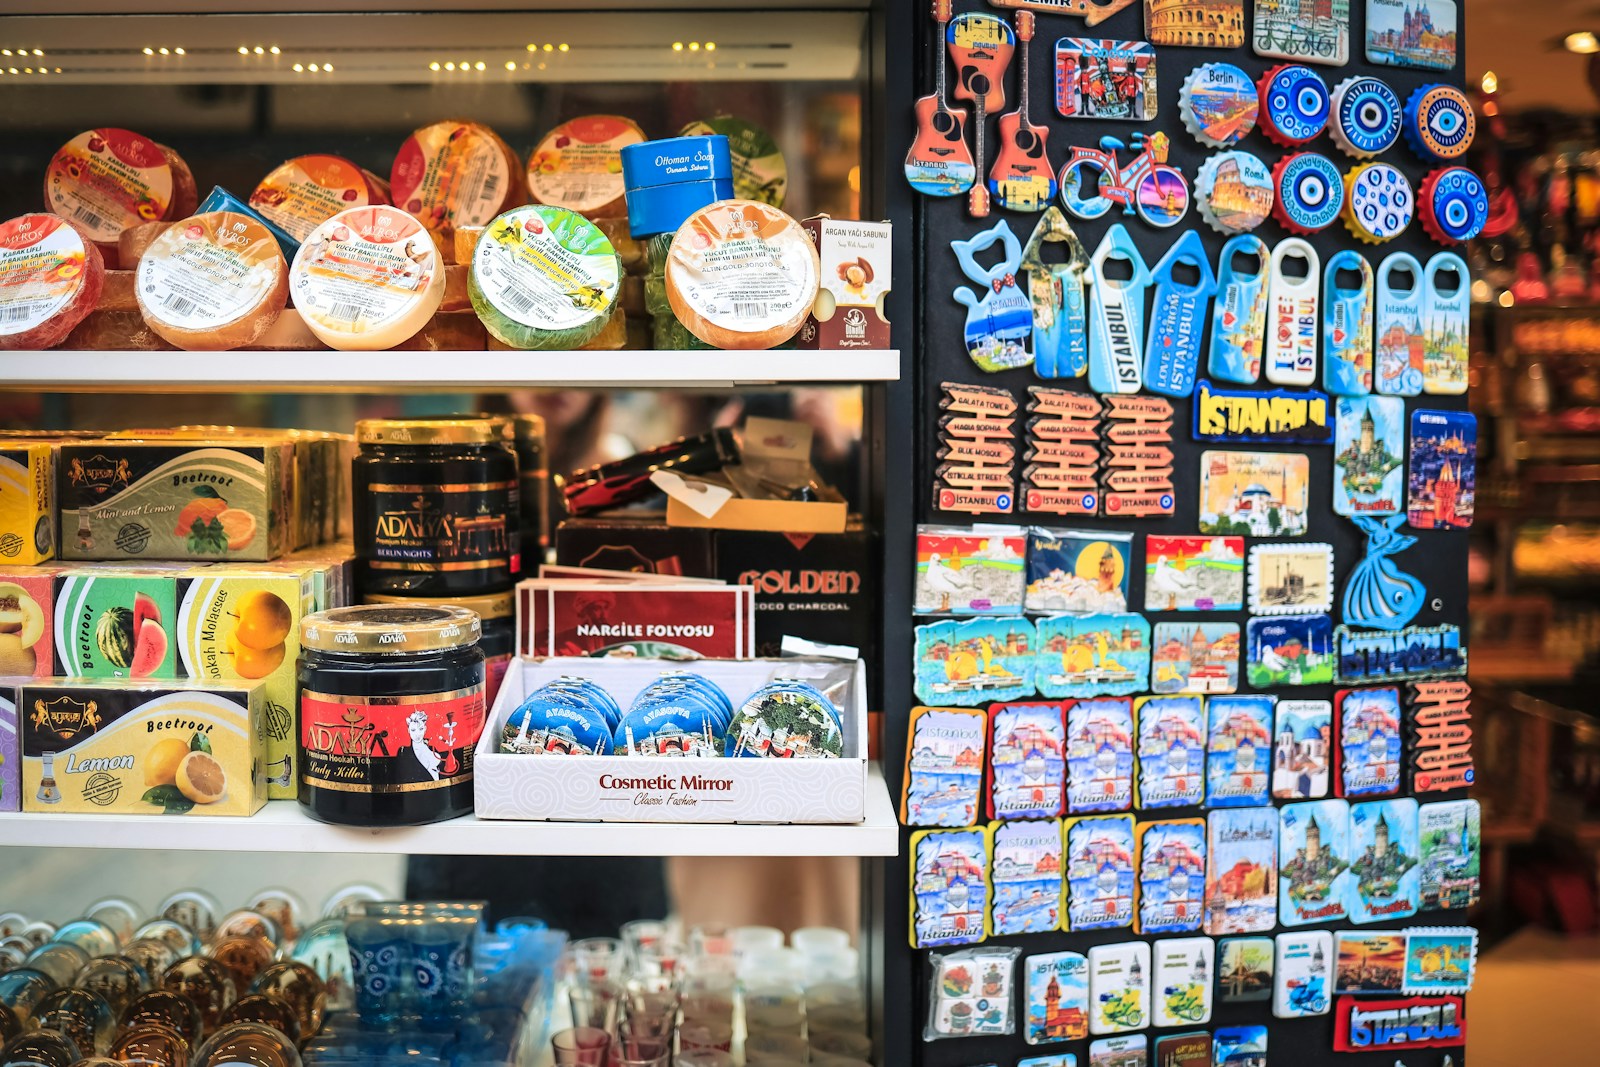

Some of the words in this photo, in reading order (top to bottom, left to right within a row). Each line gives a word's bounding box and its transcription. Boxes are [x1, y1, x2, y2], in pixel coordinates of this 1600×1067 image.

[1082, 44, 1134, 59] London
[1209, 69, 1234, 84] Berlin
[108, 156, 126, 170] KABAK
[655, 156, 689, 166] Ottoman
[694, 151, 714, 162] Soap
[109, 165, 126, 178] BAKIM
[1244, 167, 1264, 181] Roma
[5, 230, 43, 244] MYROS
[216, 226, 252, 246] MYROS
[361, 225, 400, 240] MYROS
[825, 228, 847, 236] ARGAN
[848, 228, 862, 237] YAĞI
[355, 241, 377, 250] KABAK
[377, 243, 393, 253] LİFLİ
[721, 239, 746, 249] KABAK
[3, 248, 26, 258] KABAK
[26, 246, 42, 254] LİFLİ
[8, 255, 30, 264] BAKIM
[31, 250, 58, 260] SABUNU
[358, 247, 380, 258] BAKIM
[380, 252, 406, 263] SABUNU
[546, 237, 567, 256] KABAK
[567, 253, 582, 266] LİFLİ
[205, 248, 225, 260] BAKIM
[225, 256, 250, 272] SABUNU
[546, 247, 567, 264] BAKIM
[566, 260, 592, 280] SABUNU
[1385, 304, 1418, 315] Istanbul
[1069, 278, 1085, 372] GREECE
[1157, 352, 1170, 387] LOVE
[1166, 293, 1180, 333] FROM
[1297, 297, 1315, 371] ISTANBUL
[1104, 302, 1138, 383] ISTANBUL
[1170, 297, 1196, 390] ISTANBUL
[1276, 360, 1294, 370] I
[958, 398, 983, 407] GALATA
[985, 400, 1009, 411] TOWER
[1044, 400, 1069, 409] GALATA
[1071, 402, 1094, 412] TOWER
[1144, 405, 1167, 414] TOWER
[1061, 426, 1086, 434] SOPHIA
[975, 448, 1002, 458] MOSQUE
[1059, 450, 1085, 458] MOSQUE
[173, 472, 234, 487] Beetroot
[977, 473, 1002, 481] STREET
[956, 493, 996, 506] İSTANBUL
[1042, 493, 1082, 506] İSTANBUL
[1122, 495, 1159, 507] İSTANBUL
[96, 509, 118, 519] Mint
[122, 506, 141, 516] and
[144, 503, 176, 514] Lemon
[376, 538, 400, 546] Premium
[378, 549, 401, 557] BERLIN
[738, 570, 860, 594] GOLDEN
[202, 590, 228, 641] Molasses
[82, 604, 94, 669] Beetroot
[577, 622, 642, 637] NARGİLE
[646, 624, 714, 637] FOLYOSU
[334, 631, 358, 644] ADALYA
[378, 631, 407, 643] ADALYA
[202, 645, 222, 679] ookah
[545, 708, 590, 732] AYASOFYA
[642, 708, 691, 724] AYASOFYA
[147, 720, 213, 734] Beetroot
[306, 723, 389, 757] ADALYA
[65, 754, 134, 774] Lemon
[306, 750, 328, 761] Premium
[329, 754, 355, 764] Hookah
[309, 761, 332, 780] Lady
[334, 766, 365, 779] Killer
[600, 774, 676, 790] Cosmetic
[682, 774, 734, 791] Mirror
[633, 792, 663, 806] Classic
[666, 792, 697, 806] Fashion
[1073, 792, 1127, 804] Istanbul
[1146, 788, 1200, 801] Istanbul
[999, 800, 1056, 811] Istanbul
[1074, 912, 1128, 925] Istanbul
[1144, 914, 1199, 927] Istanbul
[921, 927, 978, 940] Istanbul
[1037, 959, 1087, 974] ISTANBUL
